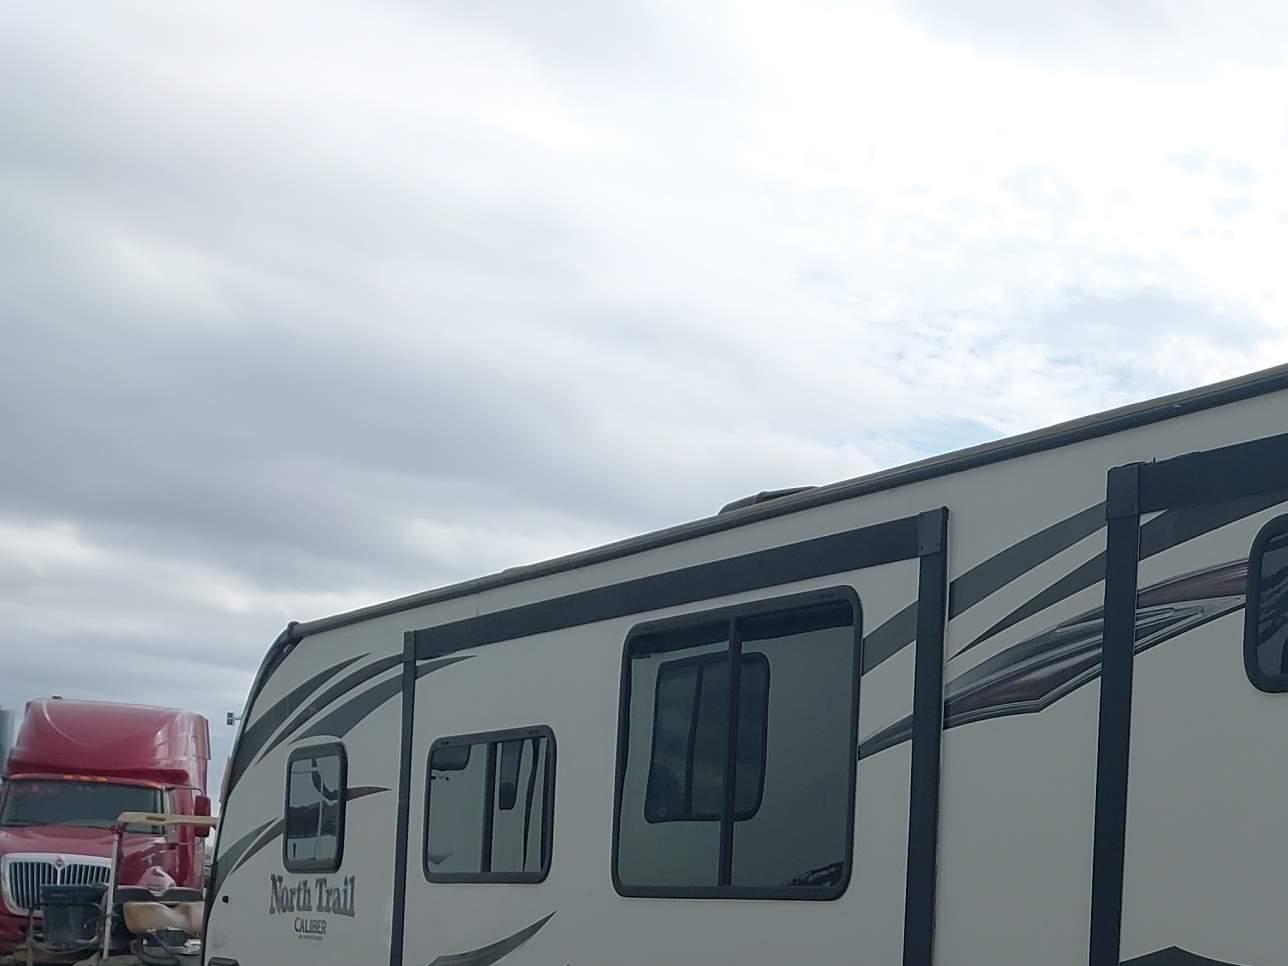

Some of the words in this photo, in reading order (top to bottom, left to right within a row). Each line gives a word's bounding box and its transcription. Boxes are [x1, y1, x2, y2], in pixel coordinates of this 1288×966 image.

[269, 874, 313, 915] North
[315, 875, 356, 918] Trail
[294, 917, 327, 935] CALIBER
